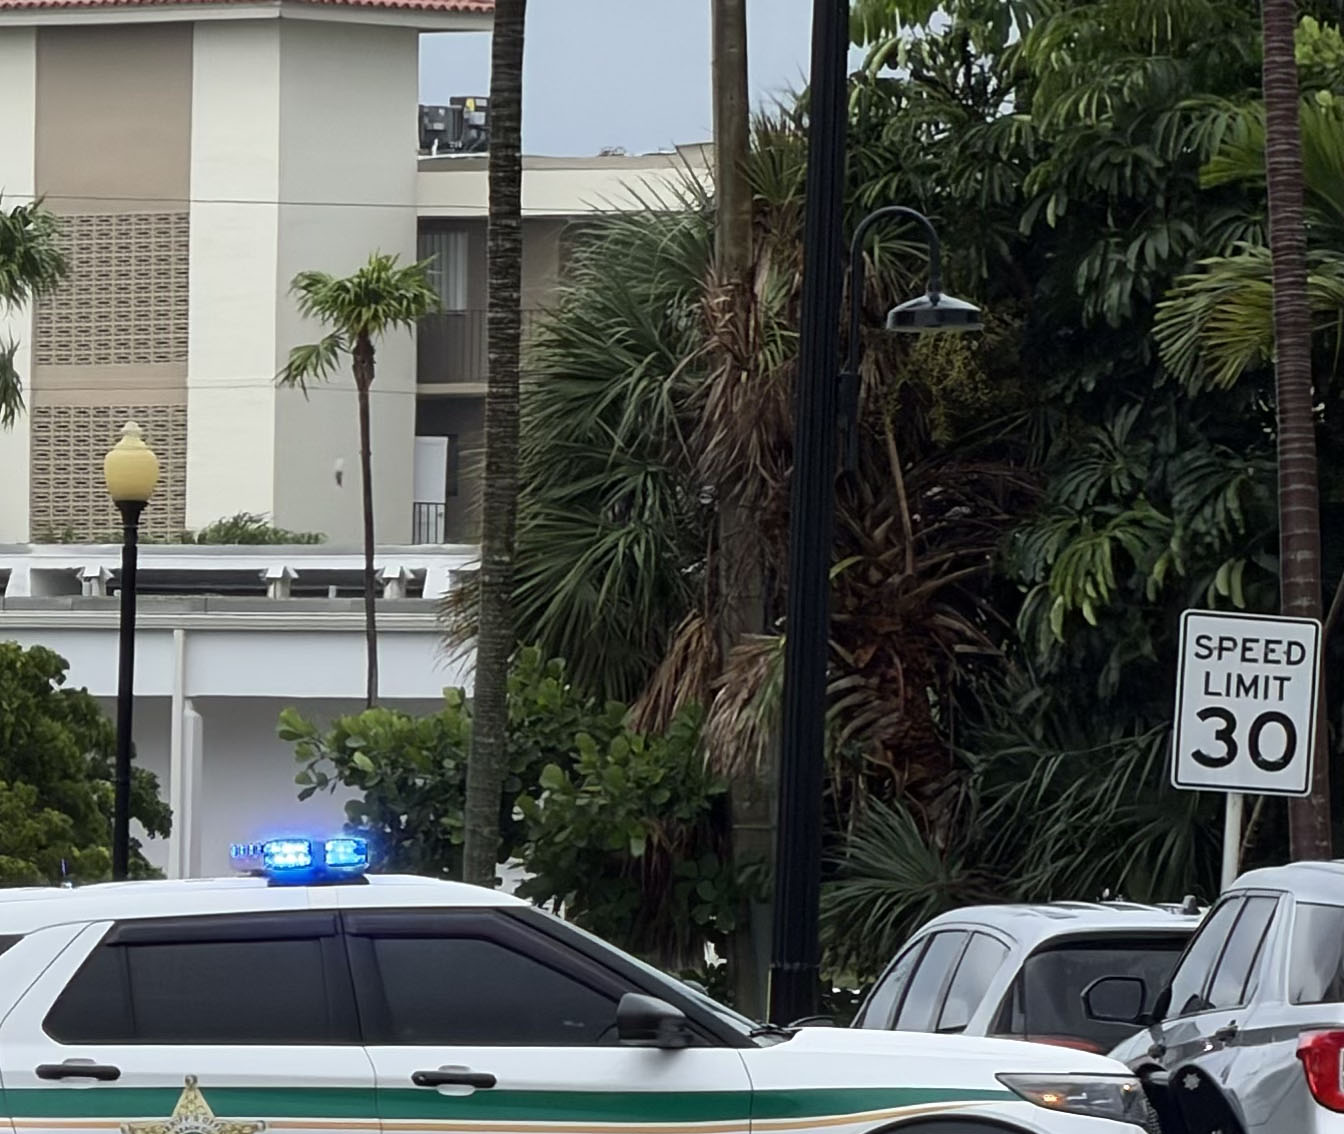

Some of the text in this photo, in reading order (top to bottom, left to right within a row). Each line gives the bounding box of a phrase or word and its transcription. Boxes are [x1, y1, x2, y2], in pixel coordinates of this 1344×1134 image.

[1194, 635, 1307, 666] SPEED
[1204, 671, 1292, 701] LIMIT
[1191, 706, 1298, 772] 30
